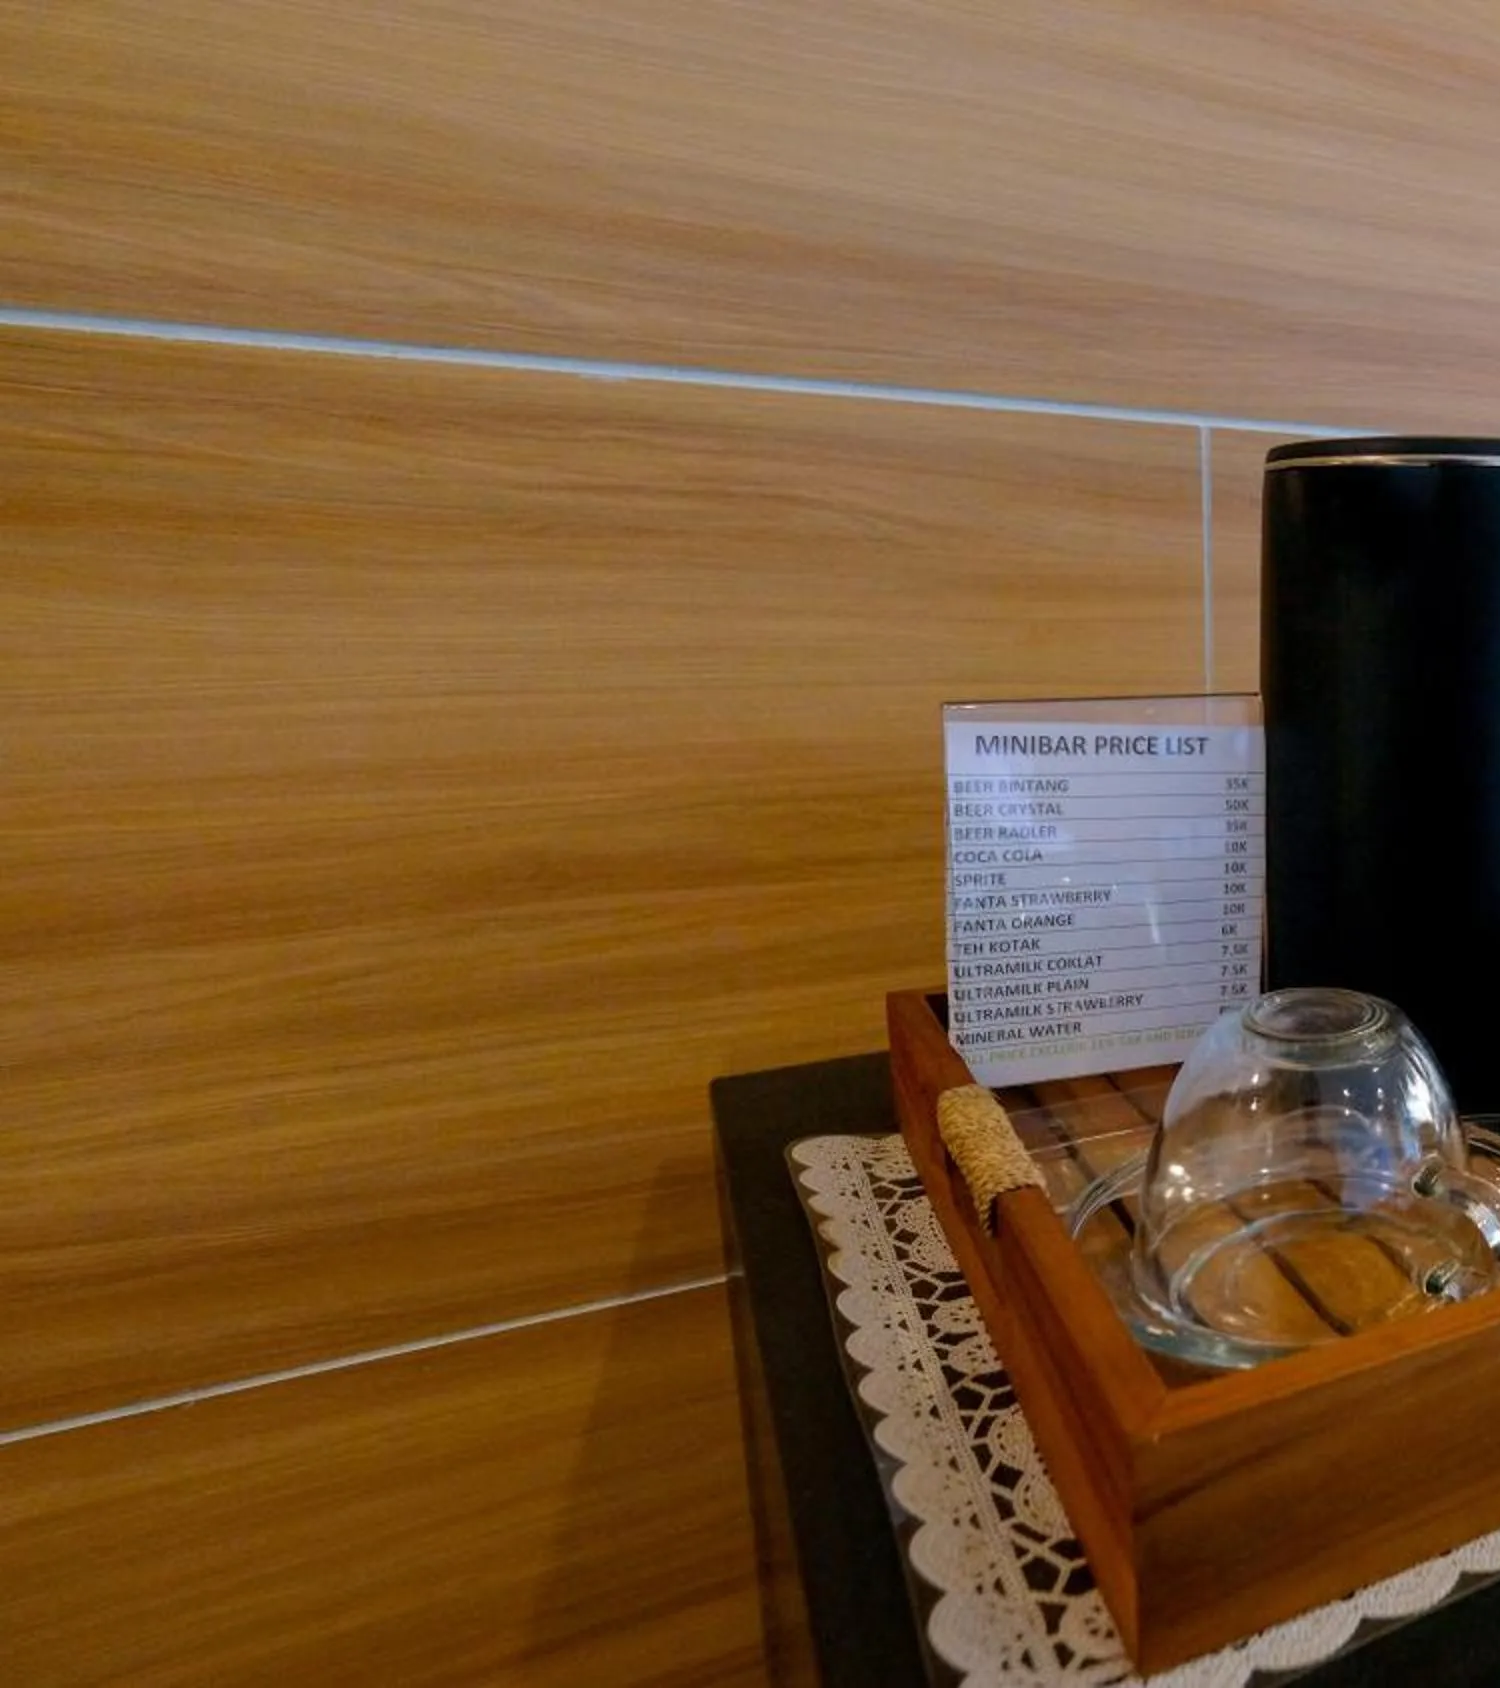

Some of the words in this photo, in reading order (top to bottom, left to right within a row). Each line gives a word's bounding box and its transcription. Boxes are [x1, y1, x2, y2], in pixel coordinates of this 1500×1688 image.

[975, 735, 1087, 756] MINIBAR
[1095, 735, 1158, 756] PRICE
[1166, 736, 1210, 755] LIST
[954, 780, 993, 793] BEER
[1000, 778, 1069, 793] BINTANG
[954, 803, 993, 817] BEER
[998, 802, 1064, 816] CRYSTAL
[954, 826, 993, 840] BEER
[998, 825, 1057, 839] RADLER
[955, 850, 998, 864] COCA
[1003, 848, 1043, 862] COLA
[955, 873, 1006, 887] SPRITE
[1223, 861, 1247, 874] 10K
[955, 896, 1006, 910] FANTA
[1011, 889, 1111, 908] STRAWBERRY
[1223, 883, 1247, 895] 10K
[954, 919, 1006, 933] FANTA
[1011, 914, 1075, 930] ORANGE
[953, 943, 983, 955] TEH
[989, 938, 1041, 953] KOTAK
[954, 961, 1041, 978] ULTRAMILK
[1048, 955, 1103, 970] COKLAT
[954, 982, 1041, 1001] ULTRAMILK
[1048, 978, 1090, 993] PLAIN
[954, 1004, 1042, 1024] ULTRAMILK
[1047, 994, 1144, 1015] STRAWBERRY
[955, 1028, 1025, 1045] MINERAL
[1029, 1021, 1082, 1038] WATER
